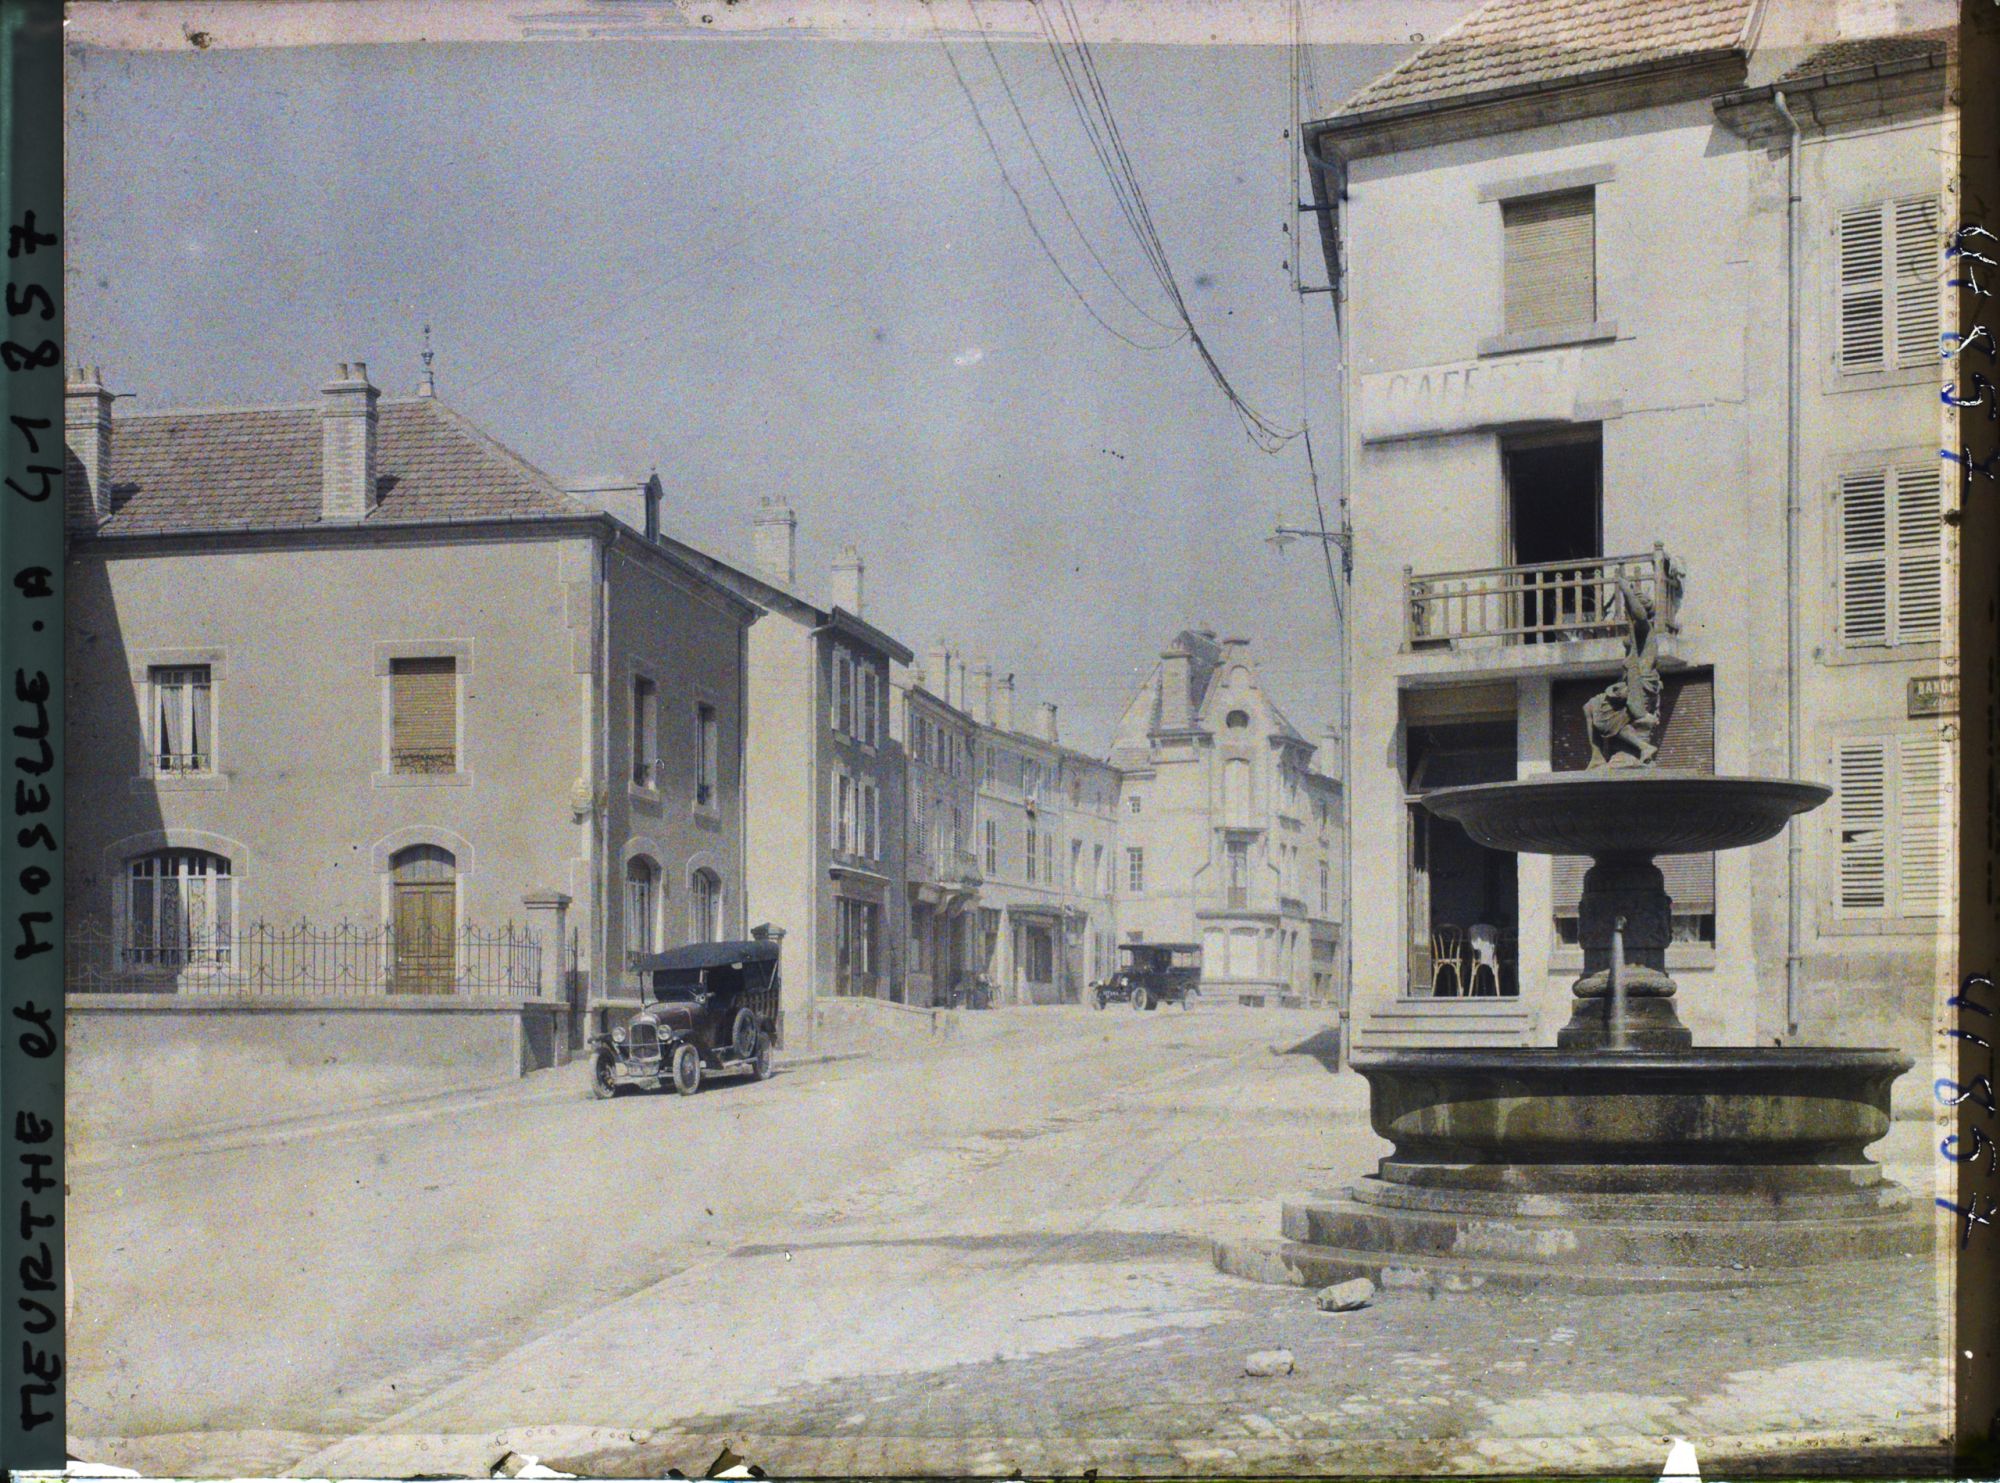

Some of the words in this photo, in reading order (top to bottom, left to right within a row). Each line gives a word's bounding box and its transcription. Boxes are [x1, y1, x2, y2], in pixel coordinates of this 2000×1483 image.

[12, 564, 56, 600] A
[10, 666, 60, 962] MOSELLE
[11, 999, 60, 1060] et
[13, 1109, 63, 1433] MEURTHE
